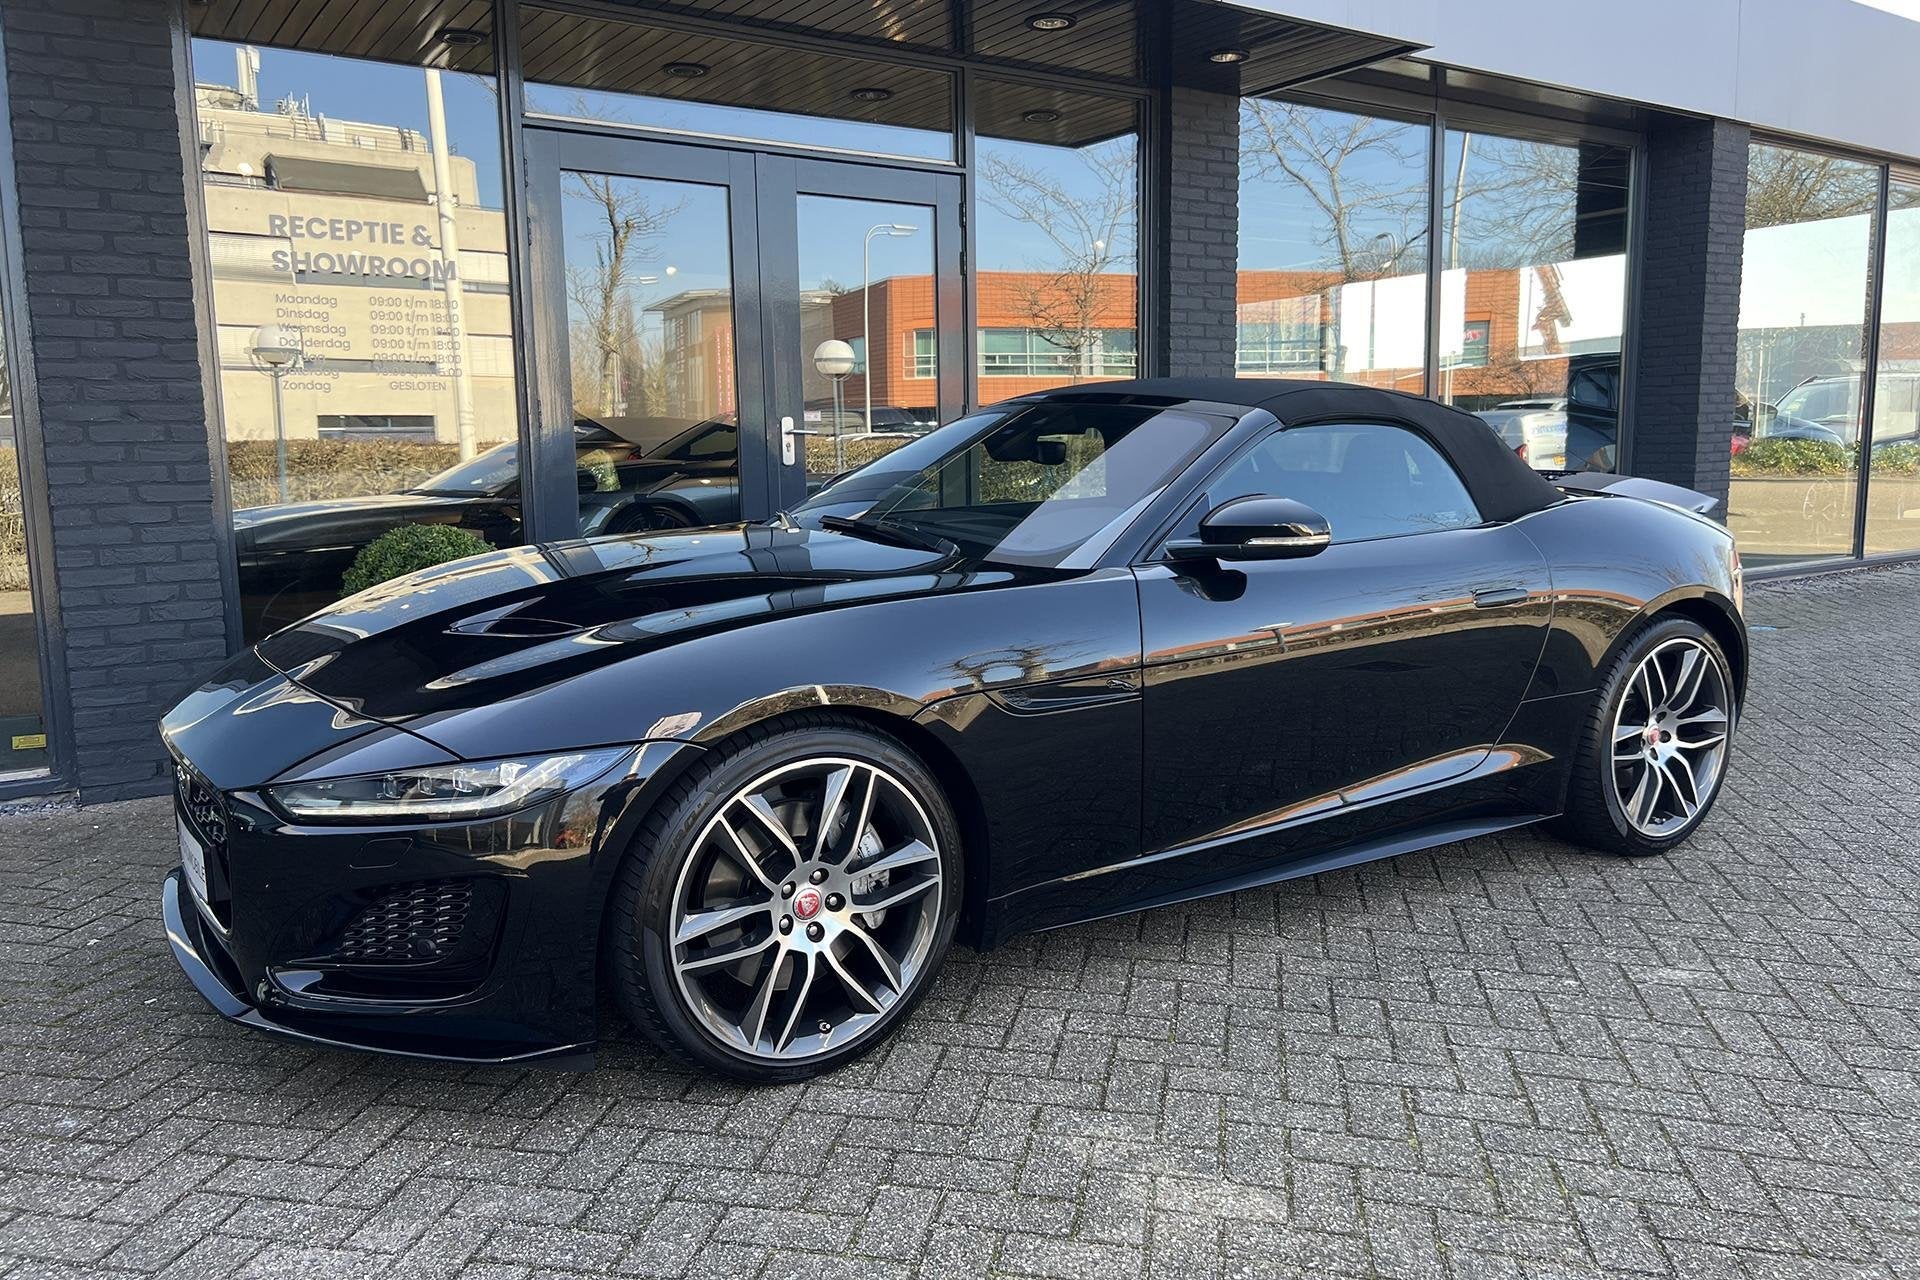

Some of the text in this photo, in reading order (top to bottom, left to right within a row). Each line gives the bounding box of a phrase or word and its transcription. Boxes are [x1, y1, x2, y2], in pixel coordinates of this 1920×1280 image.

[268, 214, 432, 247] RECEPTIE &
[271, 250, 457, 281] SHOWROOM
[275, 294, 338, 308] Maandag
[369, 296, 402, 307] 09:00
[405, 296, 427, 309] t/m
[276, 308, 329, 322] Dinsdag
[370, 310, 403, 321] 09:00
[405, 309, 428, 323] t/m
[371, 324, 404, 335] 09:00
[406, 323, 429, 337] t/m
[279, 337, 351, 351] Donderdag
[372, 338, 405, 349] 09:00
[407, 337, 430, 351] t/m
[282, 380, 447, 393] Zondag GESLOTEN
